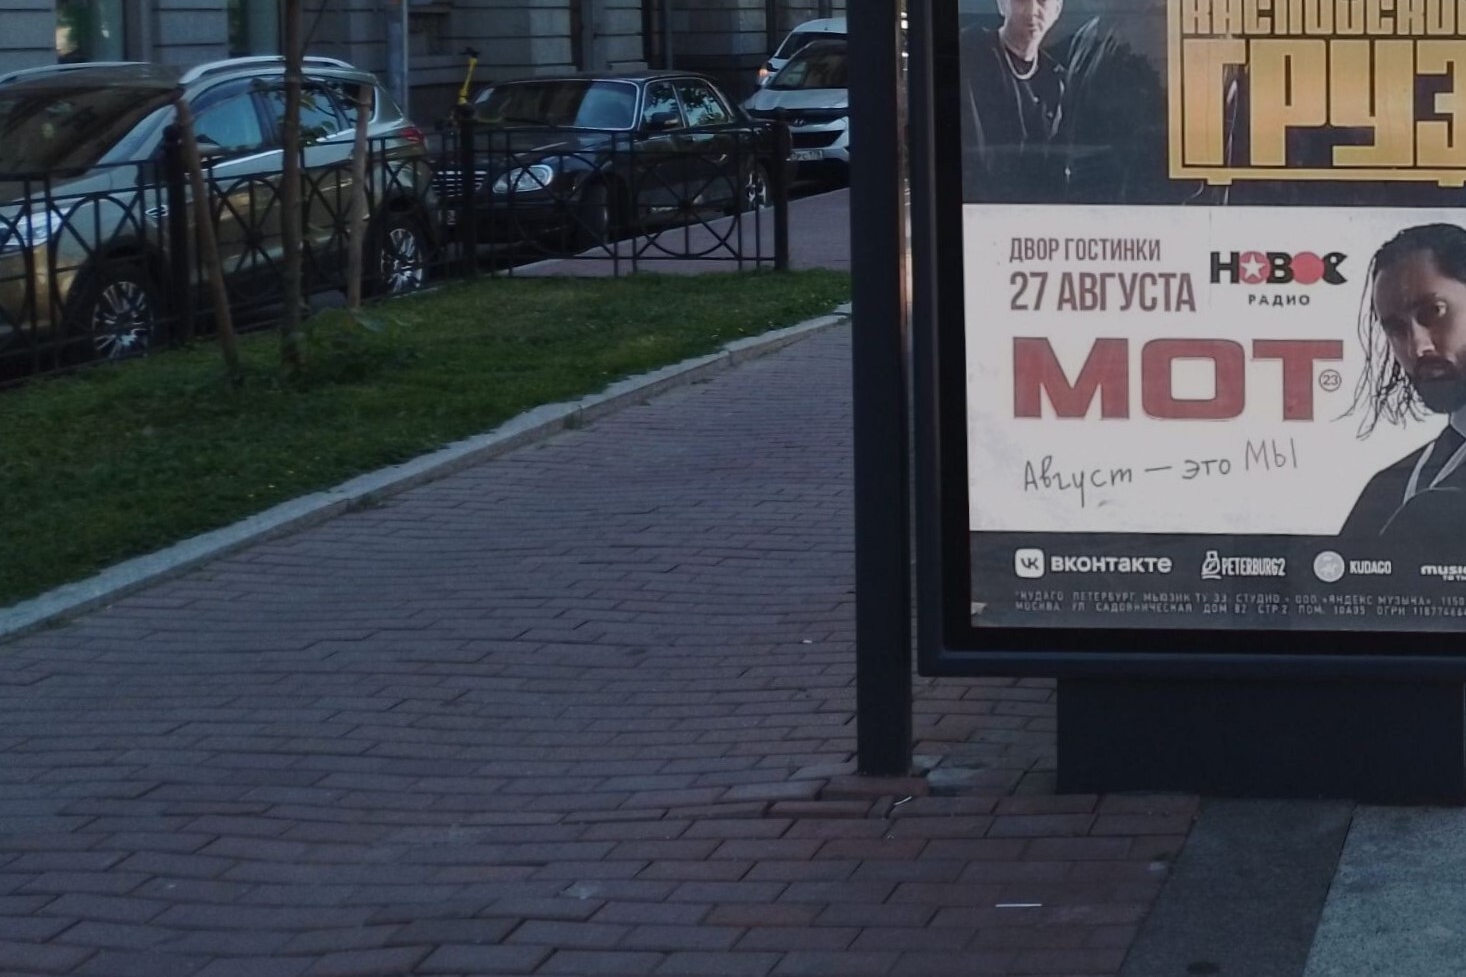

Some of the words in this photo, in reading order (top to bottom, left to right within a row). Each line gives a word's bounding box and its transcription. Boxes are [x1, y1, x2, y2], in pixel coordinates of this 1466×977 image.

[1009, 237, 1060, 263] ДВОР
[1064, 238, 1161, 262] ГОСТИНКИ
[1009, 271, 1050, 311] 27
[1056, 271, 1196, 312] АВГУСТА
[1247, 294, 1311, 307] РАДИО
[1012, 336, 1344, 422] МОТ
[1023, 453, 1134, 509] Август
[1181, 457, 1231, 481] это
[1220, 556, 1286, 576] PETERBURG2
